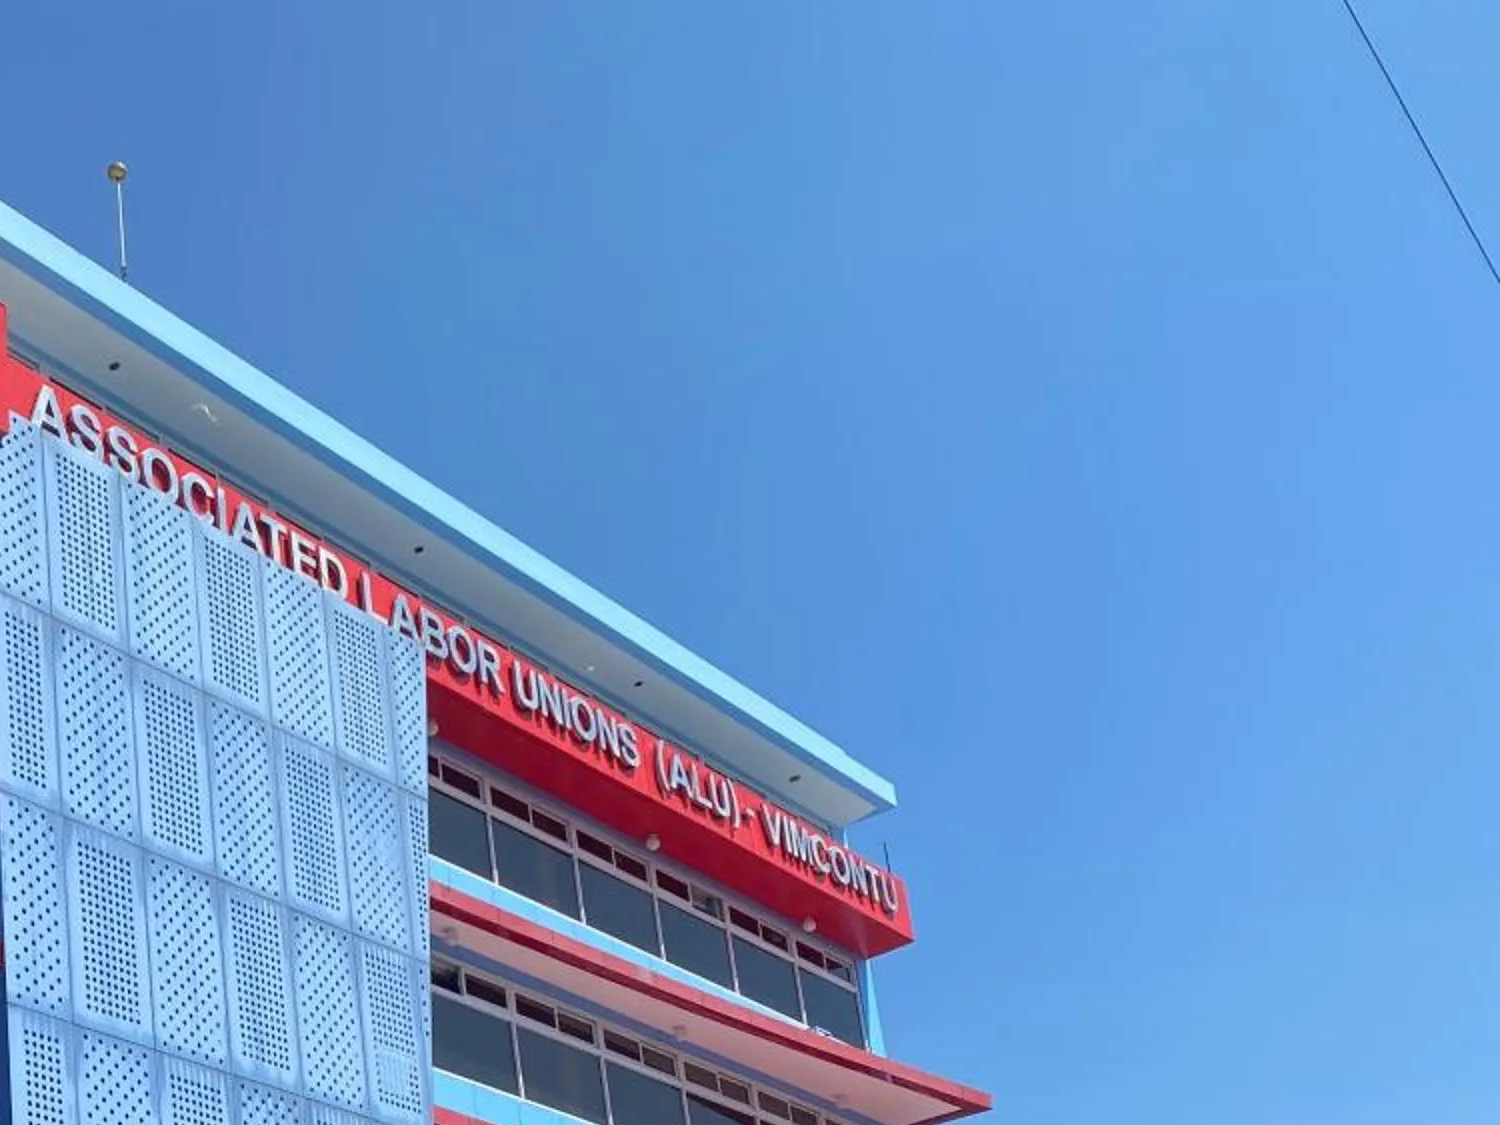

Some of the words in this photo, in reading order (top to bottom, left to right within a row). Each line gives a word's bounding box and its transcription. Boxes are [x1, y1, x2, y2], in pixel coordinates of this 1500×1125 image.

[31, 385, 348, 600] ASSOCIATED
[360, 571, 505, 694] LABOR
[514, 660, 641, 768] UNIONS
[762, 803, 899, 912] VIMCONTU
